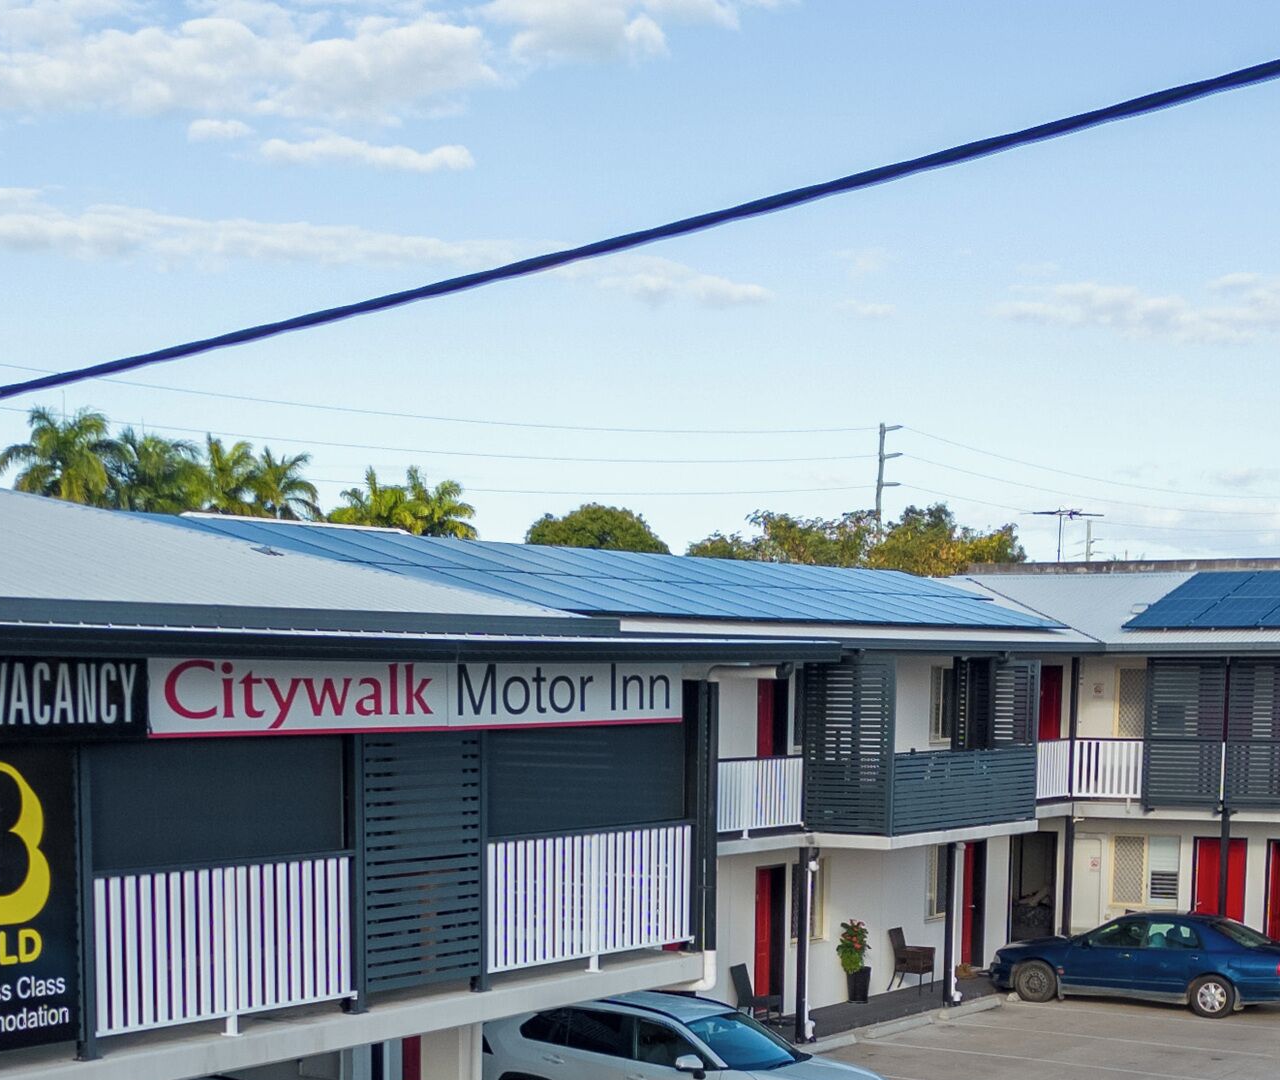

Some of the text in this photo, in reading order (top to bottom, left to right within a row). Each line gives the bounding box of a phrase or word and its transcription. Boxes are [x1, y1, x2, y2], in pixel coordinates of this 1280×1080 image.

[164, 660, 671, 729] Citywalk Motor Inn
[17, 975, 66, 1000] Class
